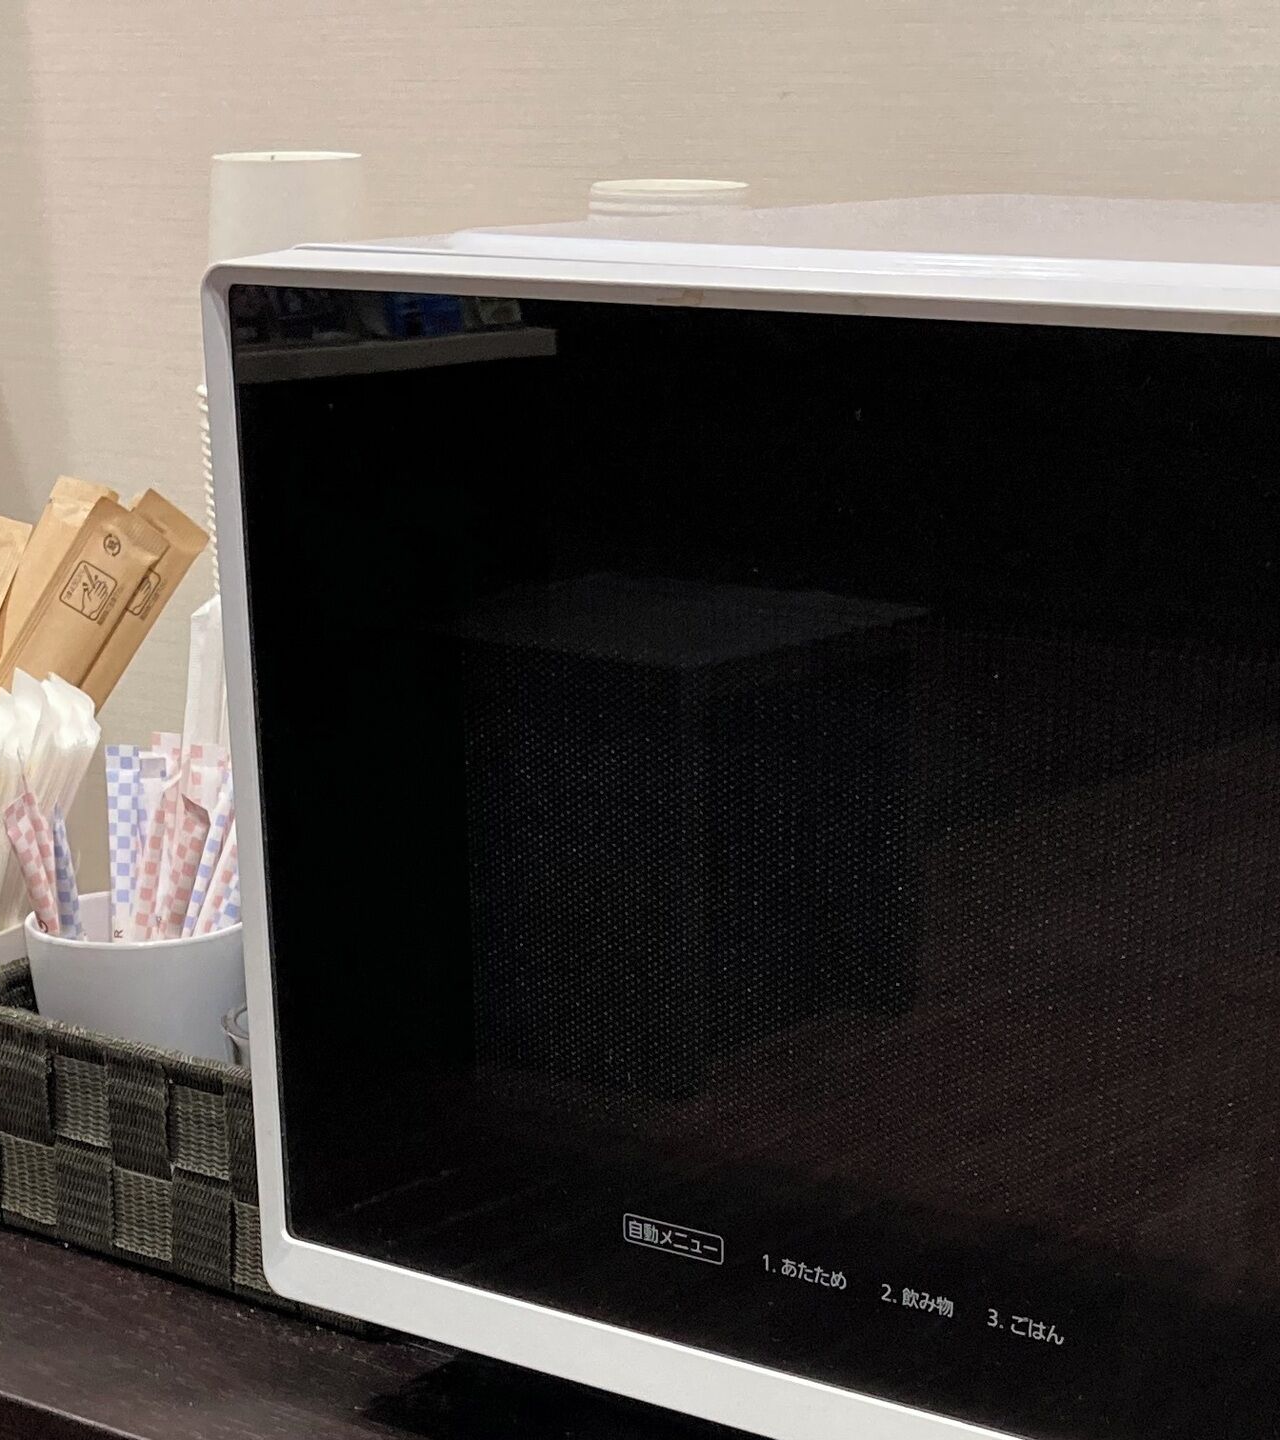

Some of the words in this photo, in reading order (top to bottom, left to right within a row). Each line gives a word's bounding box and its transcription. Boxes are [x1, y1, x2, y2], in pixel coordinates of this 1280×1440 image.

[627, 1219, 719, 1254] 自動メニュー
